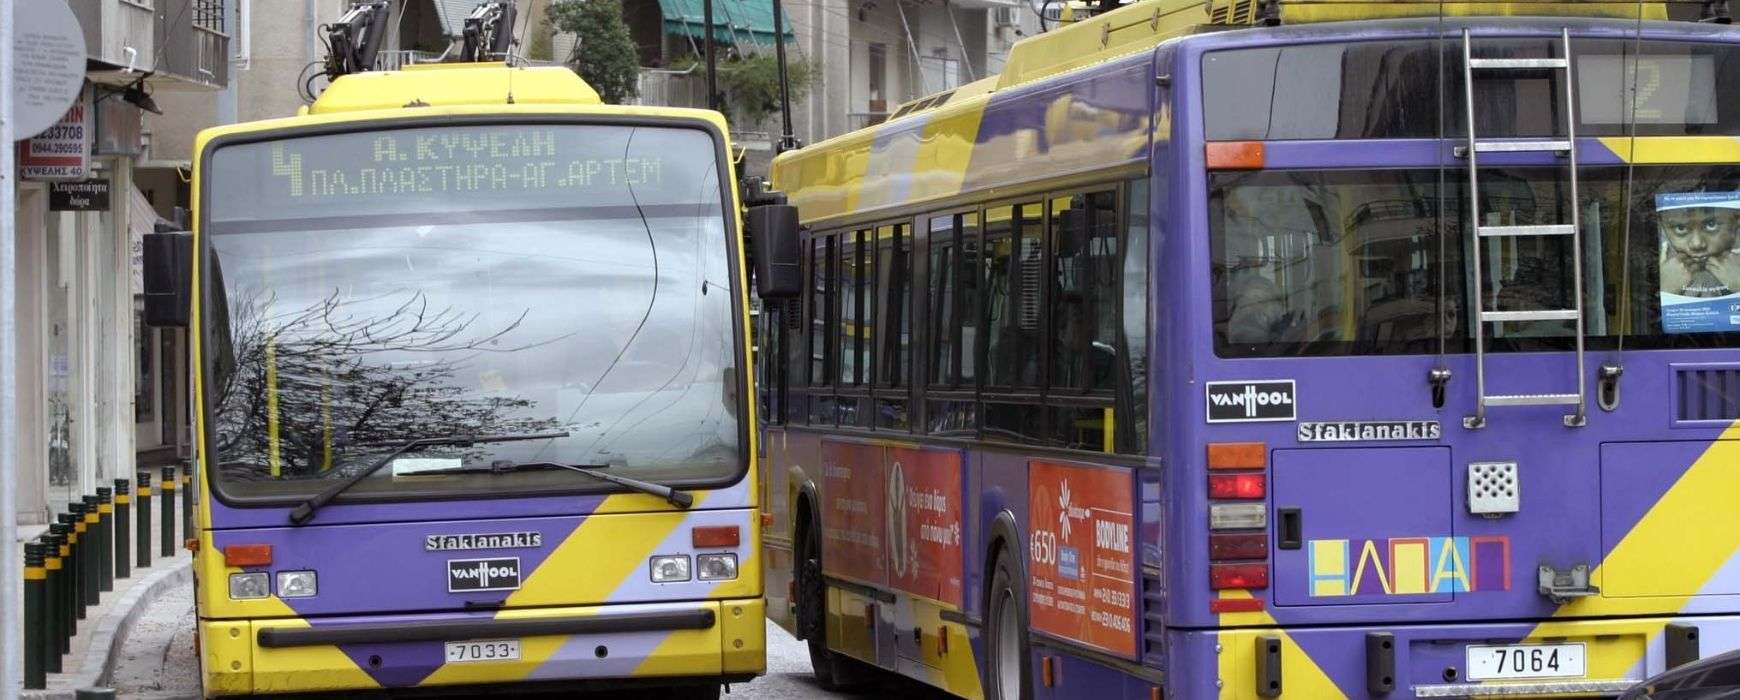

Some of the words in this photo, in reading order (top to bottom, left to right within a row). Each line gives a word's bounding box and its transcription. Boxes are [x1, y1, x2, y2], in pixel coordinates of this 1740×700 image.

[272, 144, 303, 196] 4
[1299, 421, 1440, 441] Sfakianakis
[1030, 529, 1056, 565] €650
[456, 644, 509, 659] 7033
[1495, 648, 1559, 673] 7064
